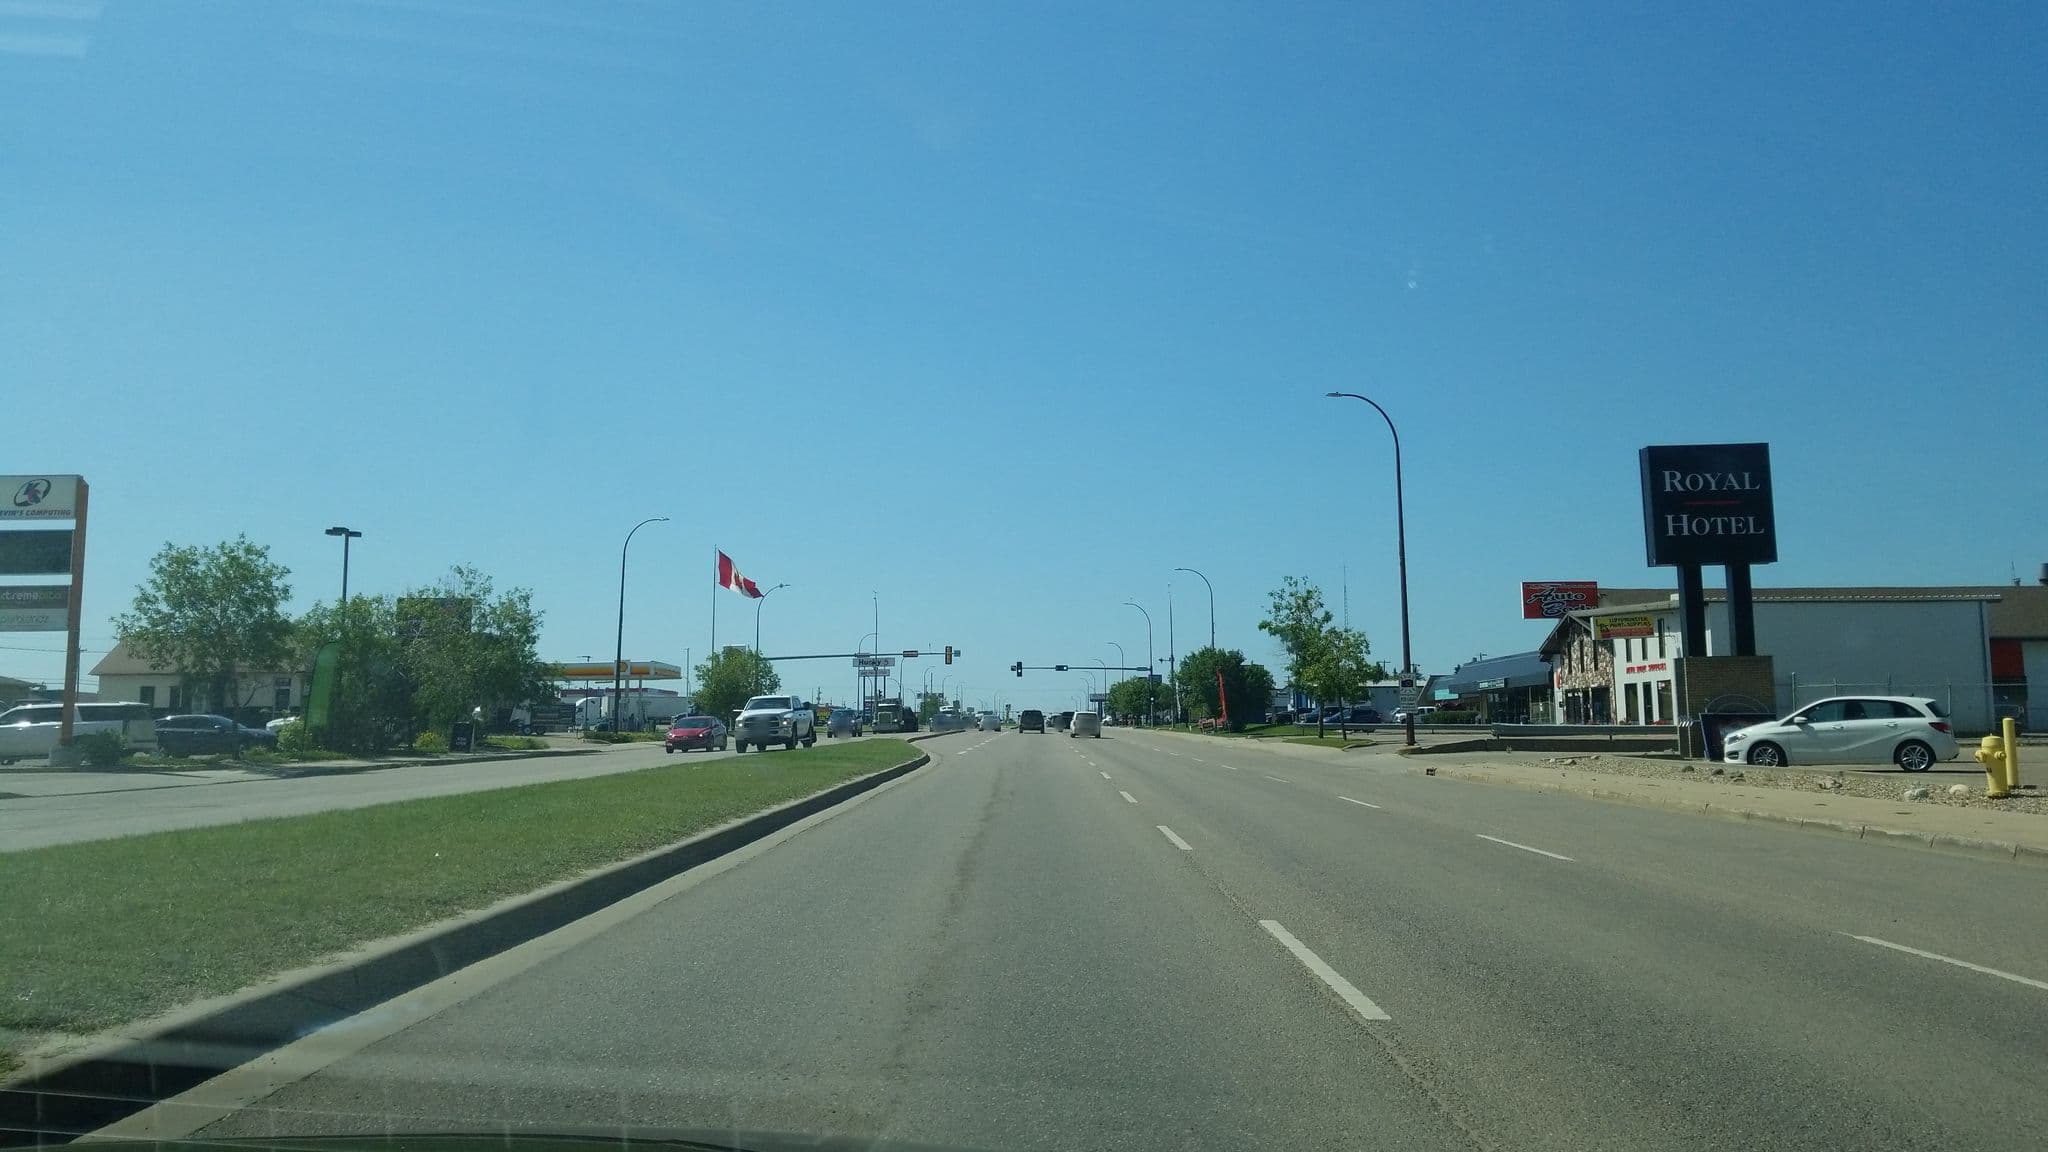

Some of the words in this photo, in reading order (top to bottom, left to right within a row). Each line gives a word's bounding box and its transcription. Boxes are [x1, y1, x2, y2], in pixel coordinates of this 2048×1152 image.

[1662, 470, 1760, 492] ROYAL
[25, 509, 72, 517] COMPUTING
[1665, 514, 1764, 536] HOTEL
[1527, 586, 1587, 604] Auto
